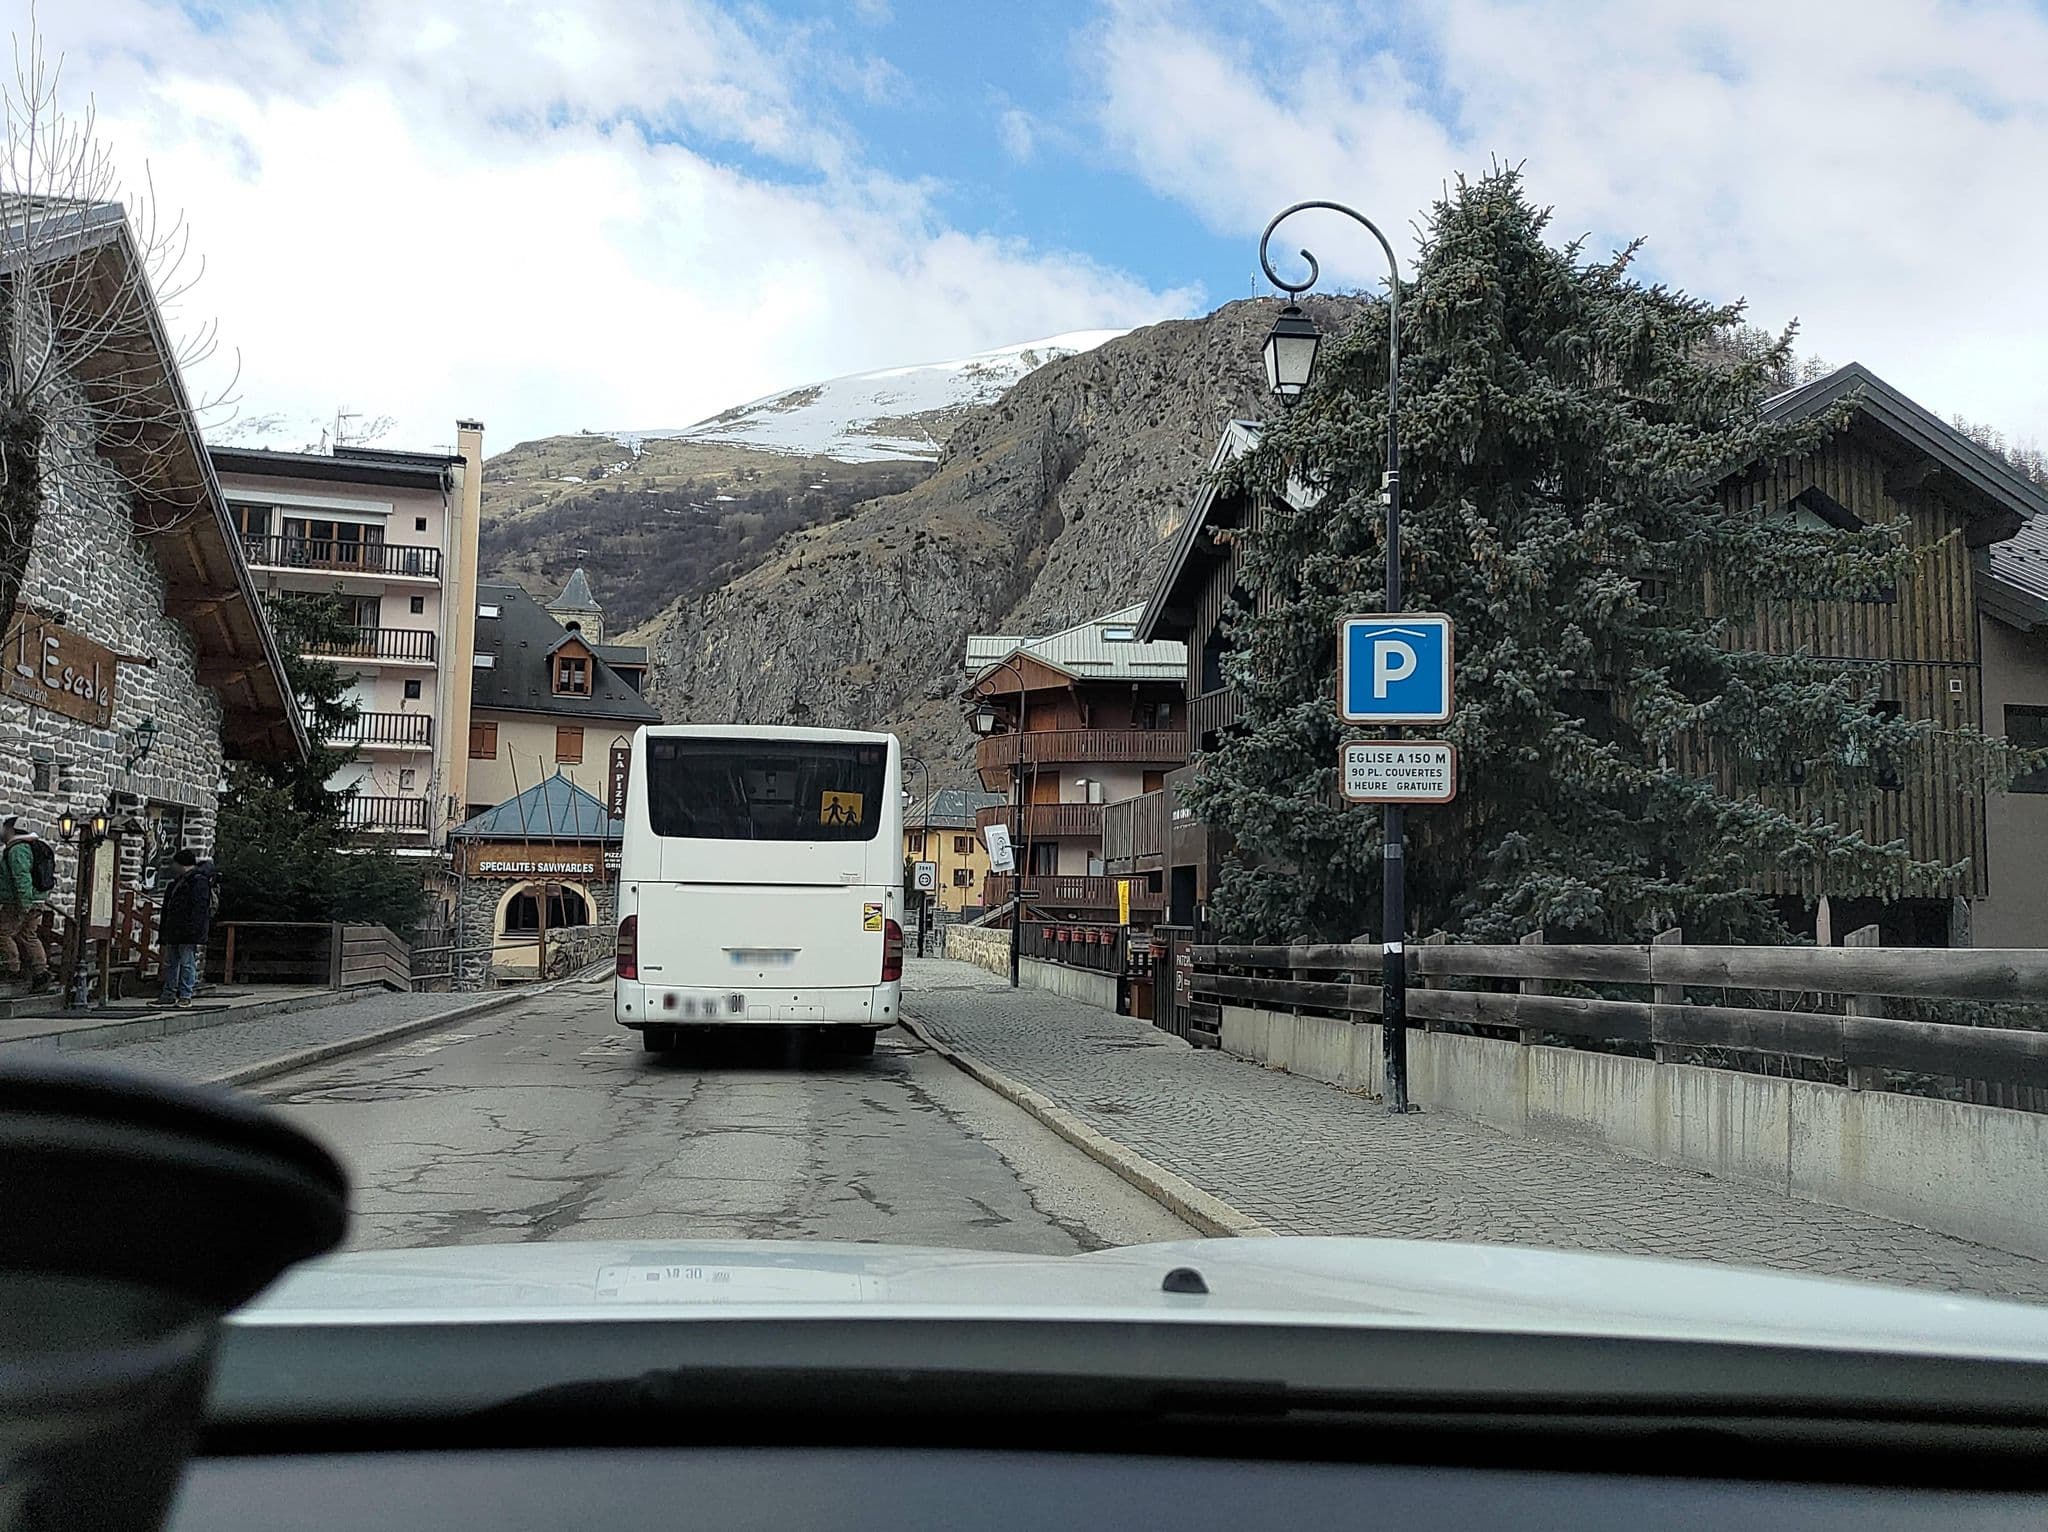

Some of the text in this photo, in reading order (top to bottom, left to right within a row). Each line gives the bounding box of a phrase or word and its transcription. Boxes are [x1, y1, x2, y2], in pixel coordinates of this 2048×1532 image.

[16, 622, 109, 707] L'Escale
[1374, 640, 1417, 698] P
[1348, 752, 1446, 764] EGLISE A 150 M
[1351, 768, 1442, 777] 90 PL. COUVERTES
[613, 753, 625, 814] LA PIZZA
[1347, 781, 1443, 791] 1 HEURE GRATUITE
[479, 861, 594, 874] SPECIALITES SAVOYARDES
